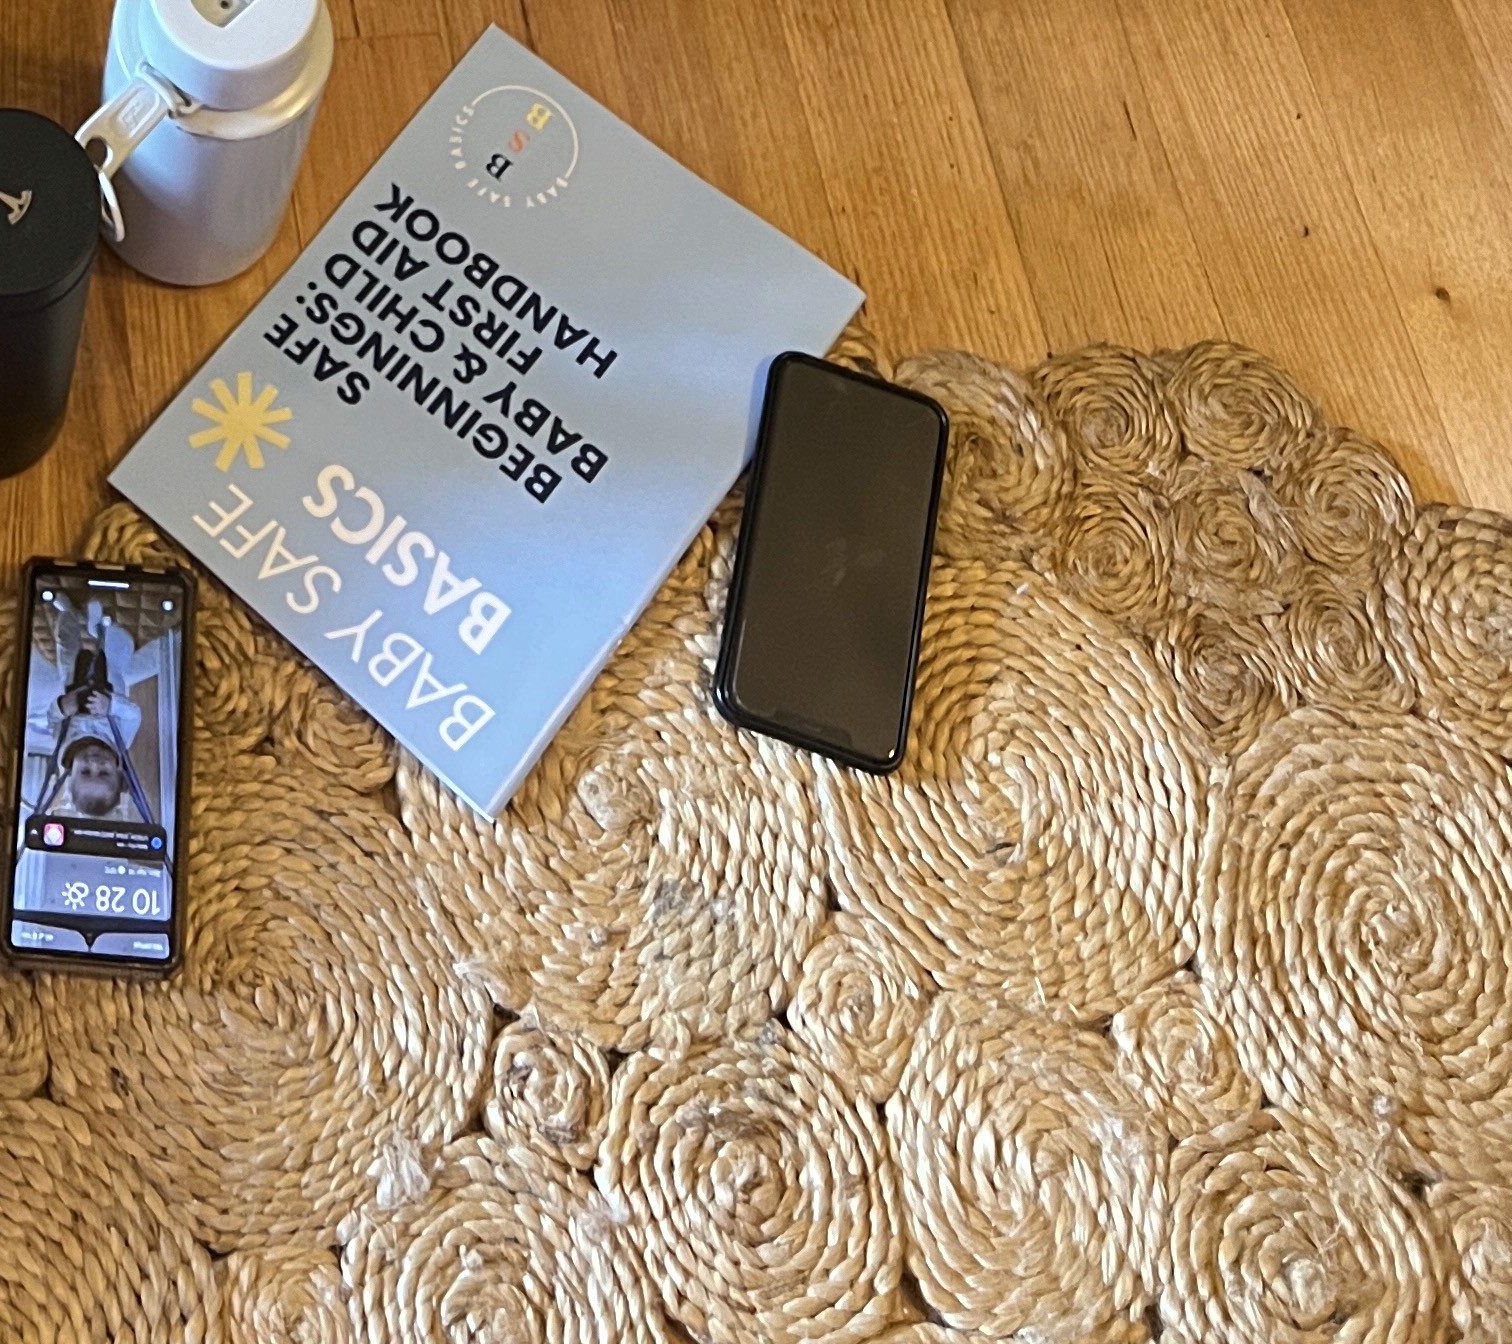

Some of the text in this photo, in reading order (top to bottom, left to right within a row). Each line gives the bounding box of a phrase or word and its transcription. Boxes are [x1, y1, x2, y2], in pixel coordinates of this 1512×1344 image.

[449, 103, 569, 208] BABY SAFE BASICS
[263, 313, 371, 406] SAFE
[324, 253, 609, 484] BABY & CHILD
[351, 219, 544, 376] FIRST AID
[373, 182, 619, 380] HANDBOOK
[295, 280, 563, 505] BEGINNINGS:
[192, 483, 496, 752] BABY SAFE
[301, 463, 512, 655] BASICS
[95, 884, 161, 915] 10 28
